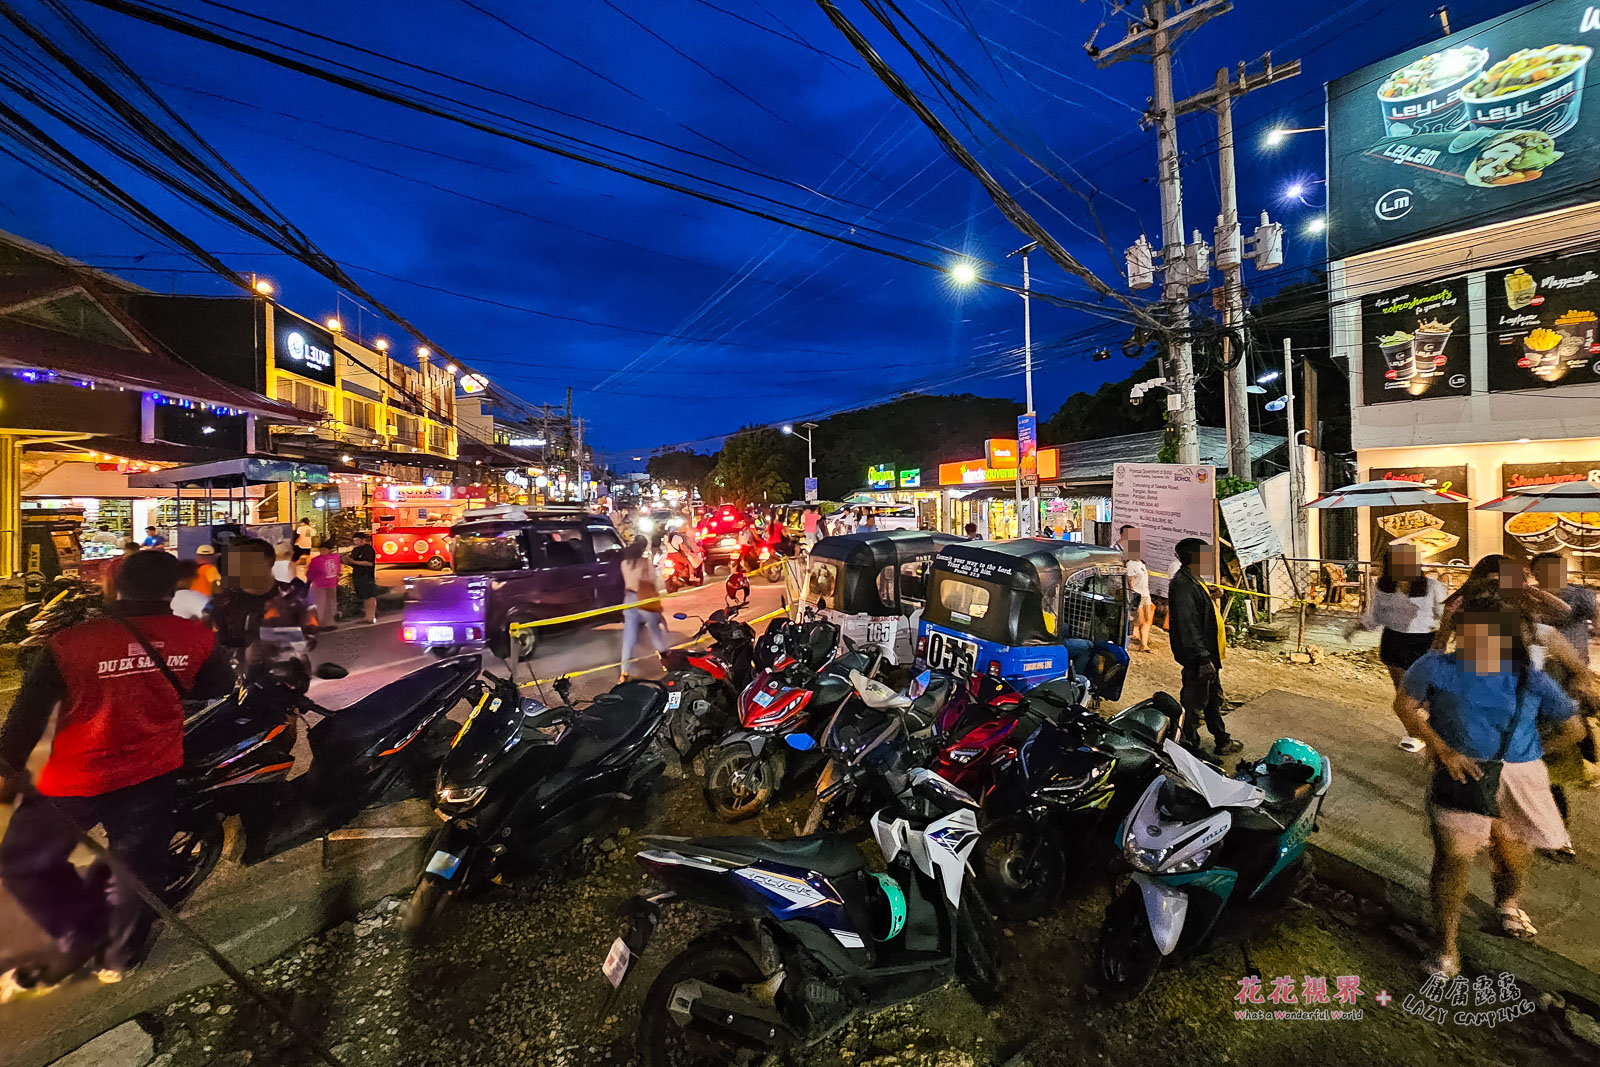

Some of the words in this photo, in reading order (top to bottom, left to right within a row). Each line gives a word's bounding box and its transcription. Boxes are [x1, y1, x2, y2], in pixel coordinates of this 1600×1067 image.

[947, 561, 961, 569] Trust
[868, 623, 889, 642] 165
[98, 659, 119, 674] DU
[119, 657, 136, 671] EK
[137, 656, 155, 668] SA
